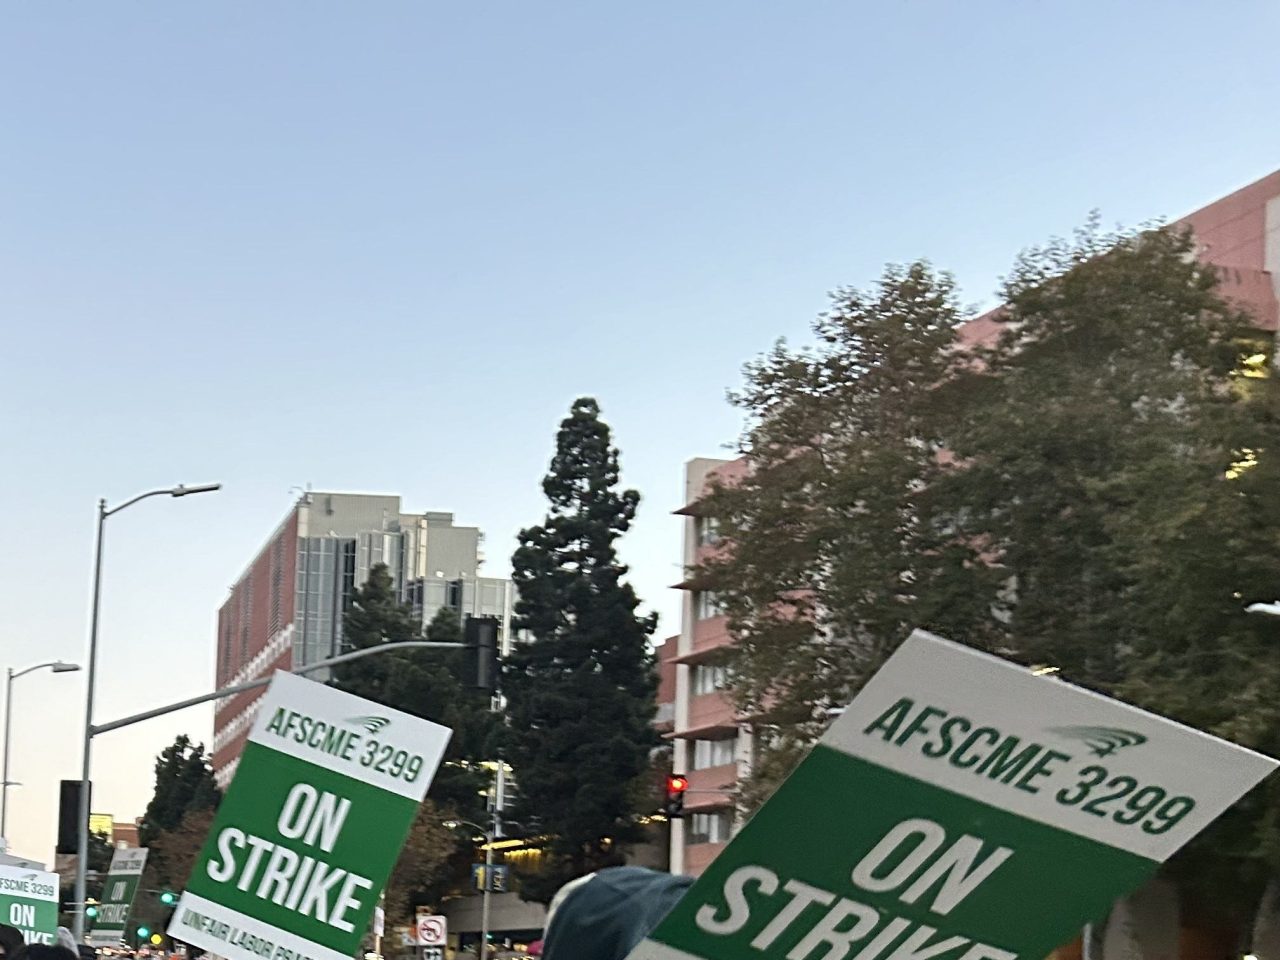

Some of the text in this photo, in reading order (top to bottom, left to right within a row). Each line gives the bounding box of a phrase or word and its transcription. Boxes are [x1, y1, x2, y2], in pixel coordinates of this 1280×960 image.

[265, 706, 423, 783] AFSCME 3299
[863, 697, 1196, 834] AFSCME 3299
[277, 783, 352, 853] ON
[31, 882, 55, 896] 3299
[206, 827, 374, 933] STRIKE
[851, 818, 1015, 916] ON
[10, 903, 35, 927] ON
[181, 907, 230, 942] UNFAIR
[228, 927, 275, 959] LABOR
